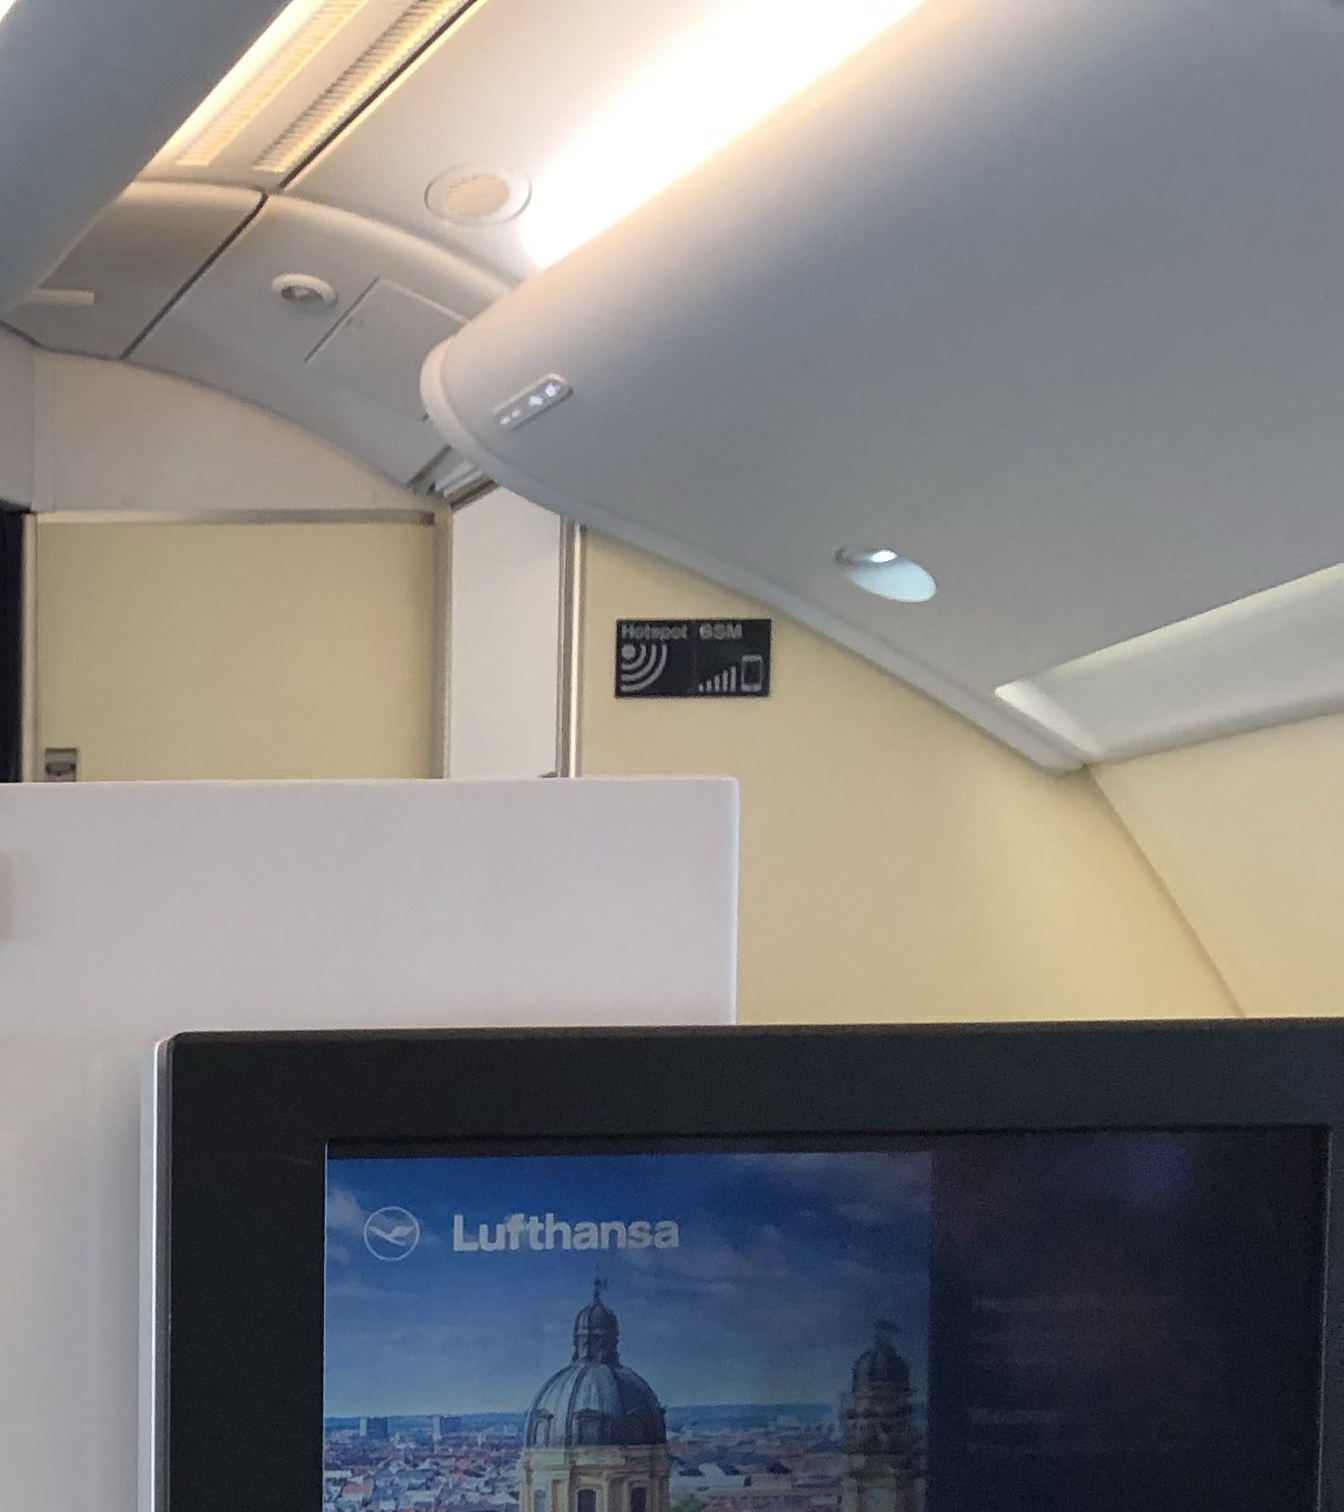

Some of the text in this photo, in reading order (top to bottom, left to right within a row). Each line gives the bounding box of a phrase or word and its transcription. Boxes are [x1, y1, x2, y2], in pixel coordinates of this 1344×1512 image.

[621, 623, 743, 640] Hotspot GSM
[453, 1213, 679, 1251] Lufthansa
